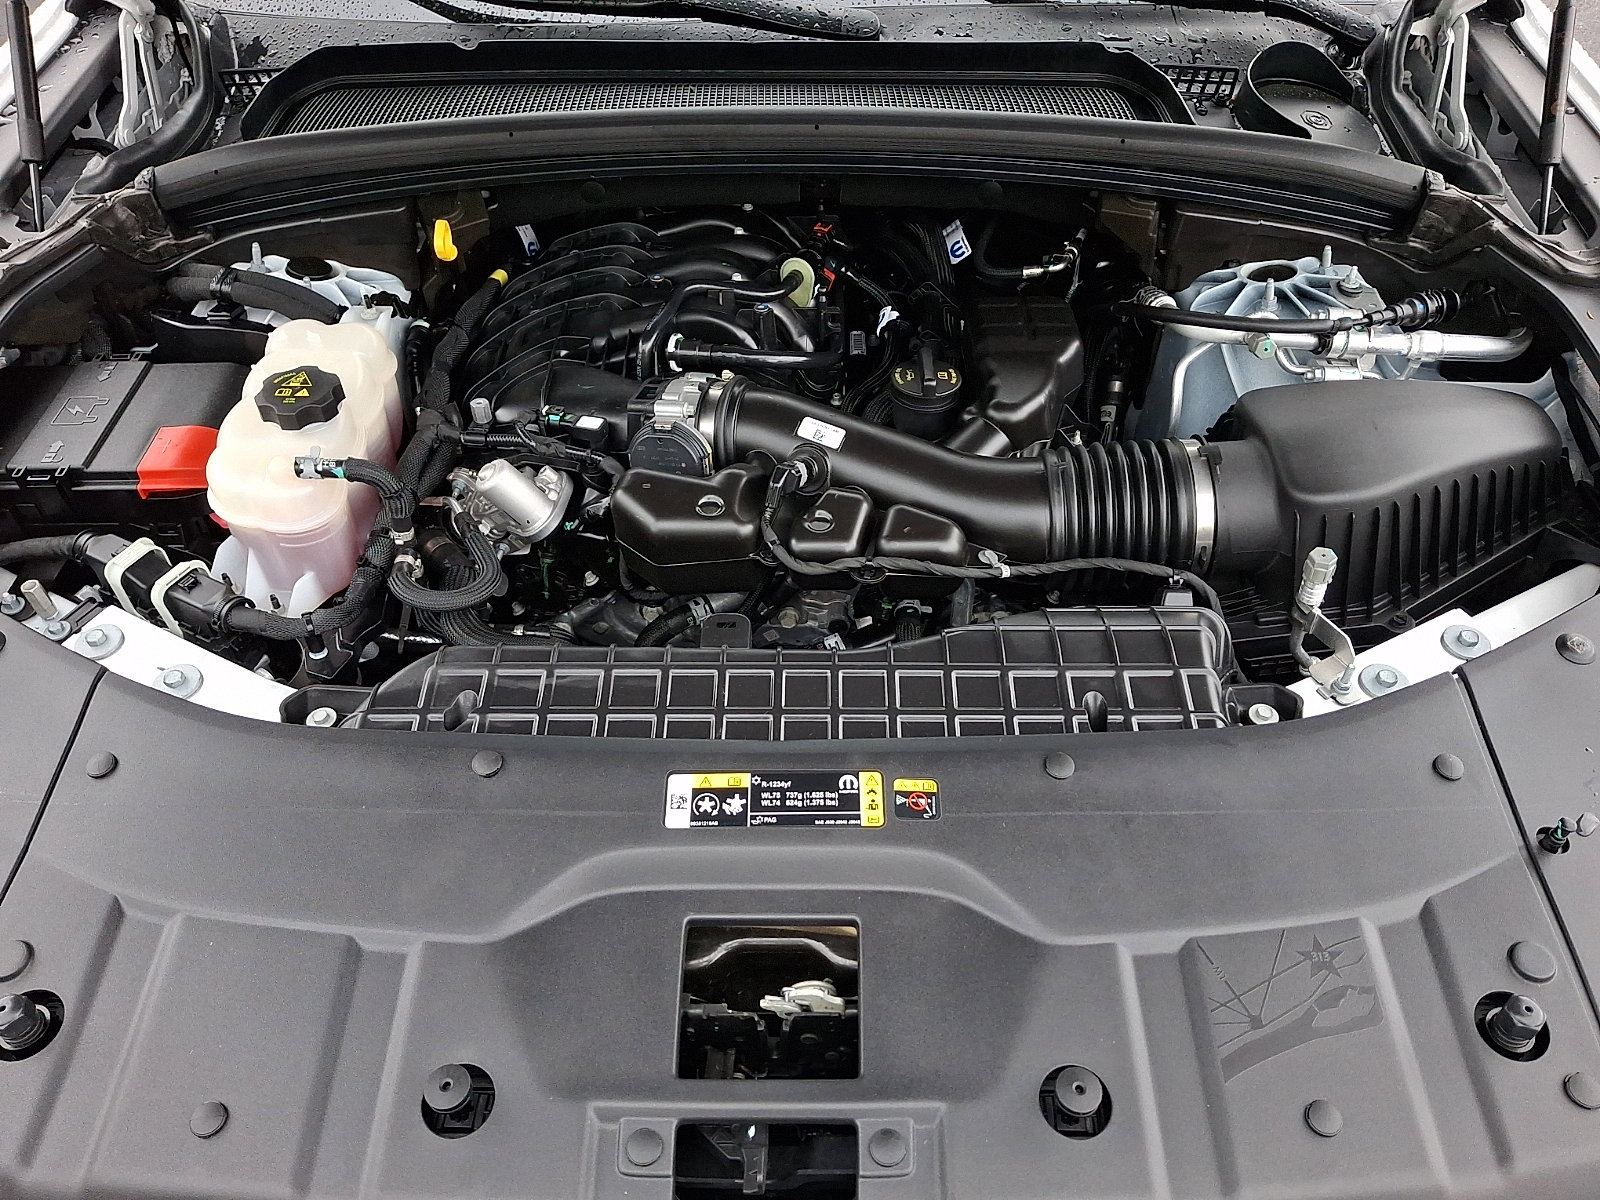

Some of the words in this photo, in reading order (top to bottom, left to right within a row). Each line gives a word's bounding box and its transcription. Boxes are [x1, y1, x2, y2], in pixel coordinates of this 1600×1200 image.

[761, 780, 792, 788] R-1234yf
[786, 792, 802, 800] 737g
[825, 791, 838, 799] lbs)
[825, 799, 838, 807] lbs)
[1311, 951, 1331, 961] 313
